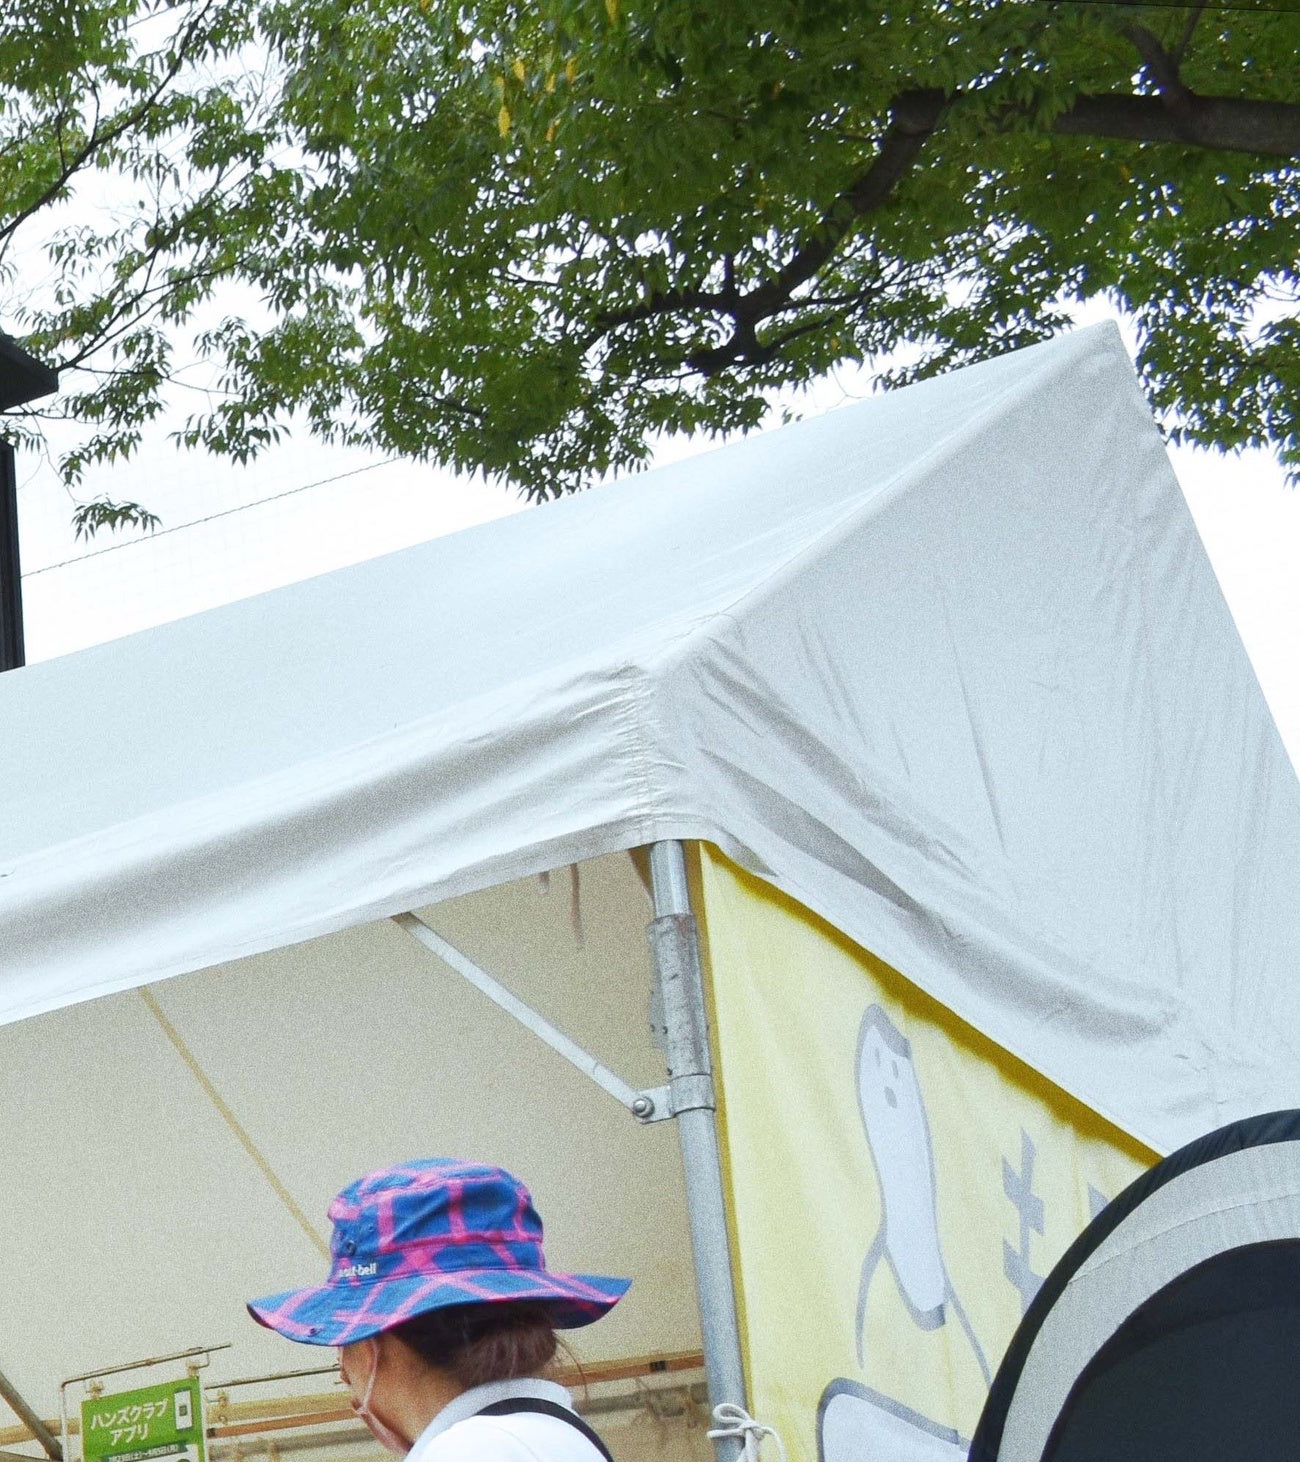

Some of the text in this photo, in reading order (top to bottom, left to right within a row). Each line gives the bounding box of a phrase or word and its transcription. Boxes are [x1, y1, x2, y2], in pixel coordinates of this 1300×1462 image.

[90, 1399, 170, 1431] ハンズクラブ
[109, 1423, 150, 1448] アプリ
